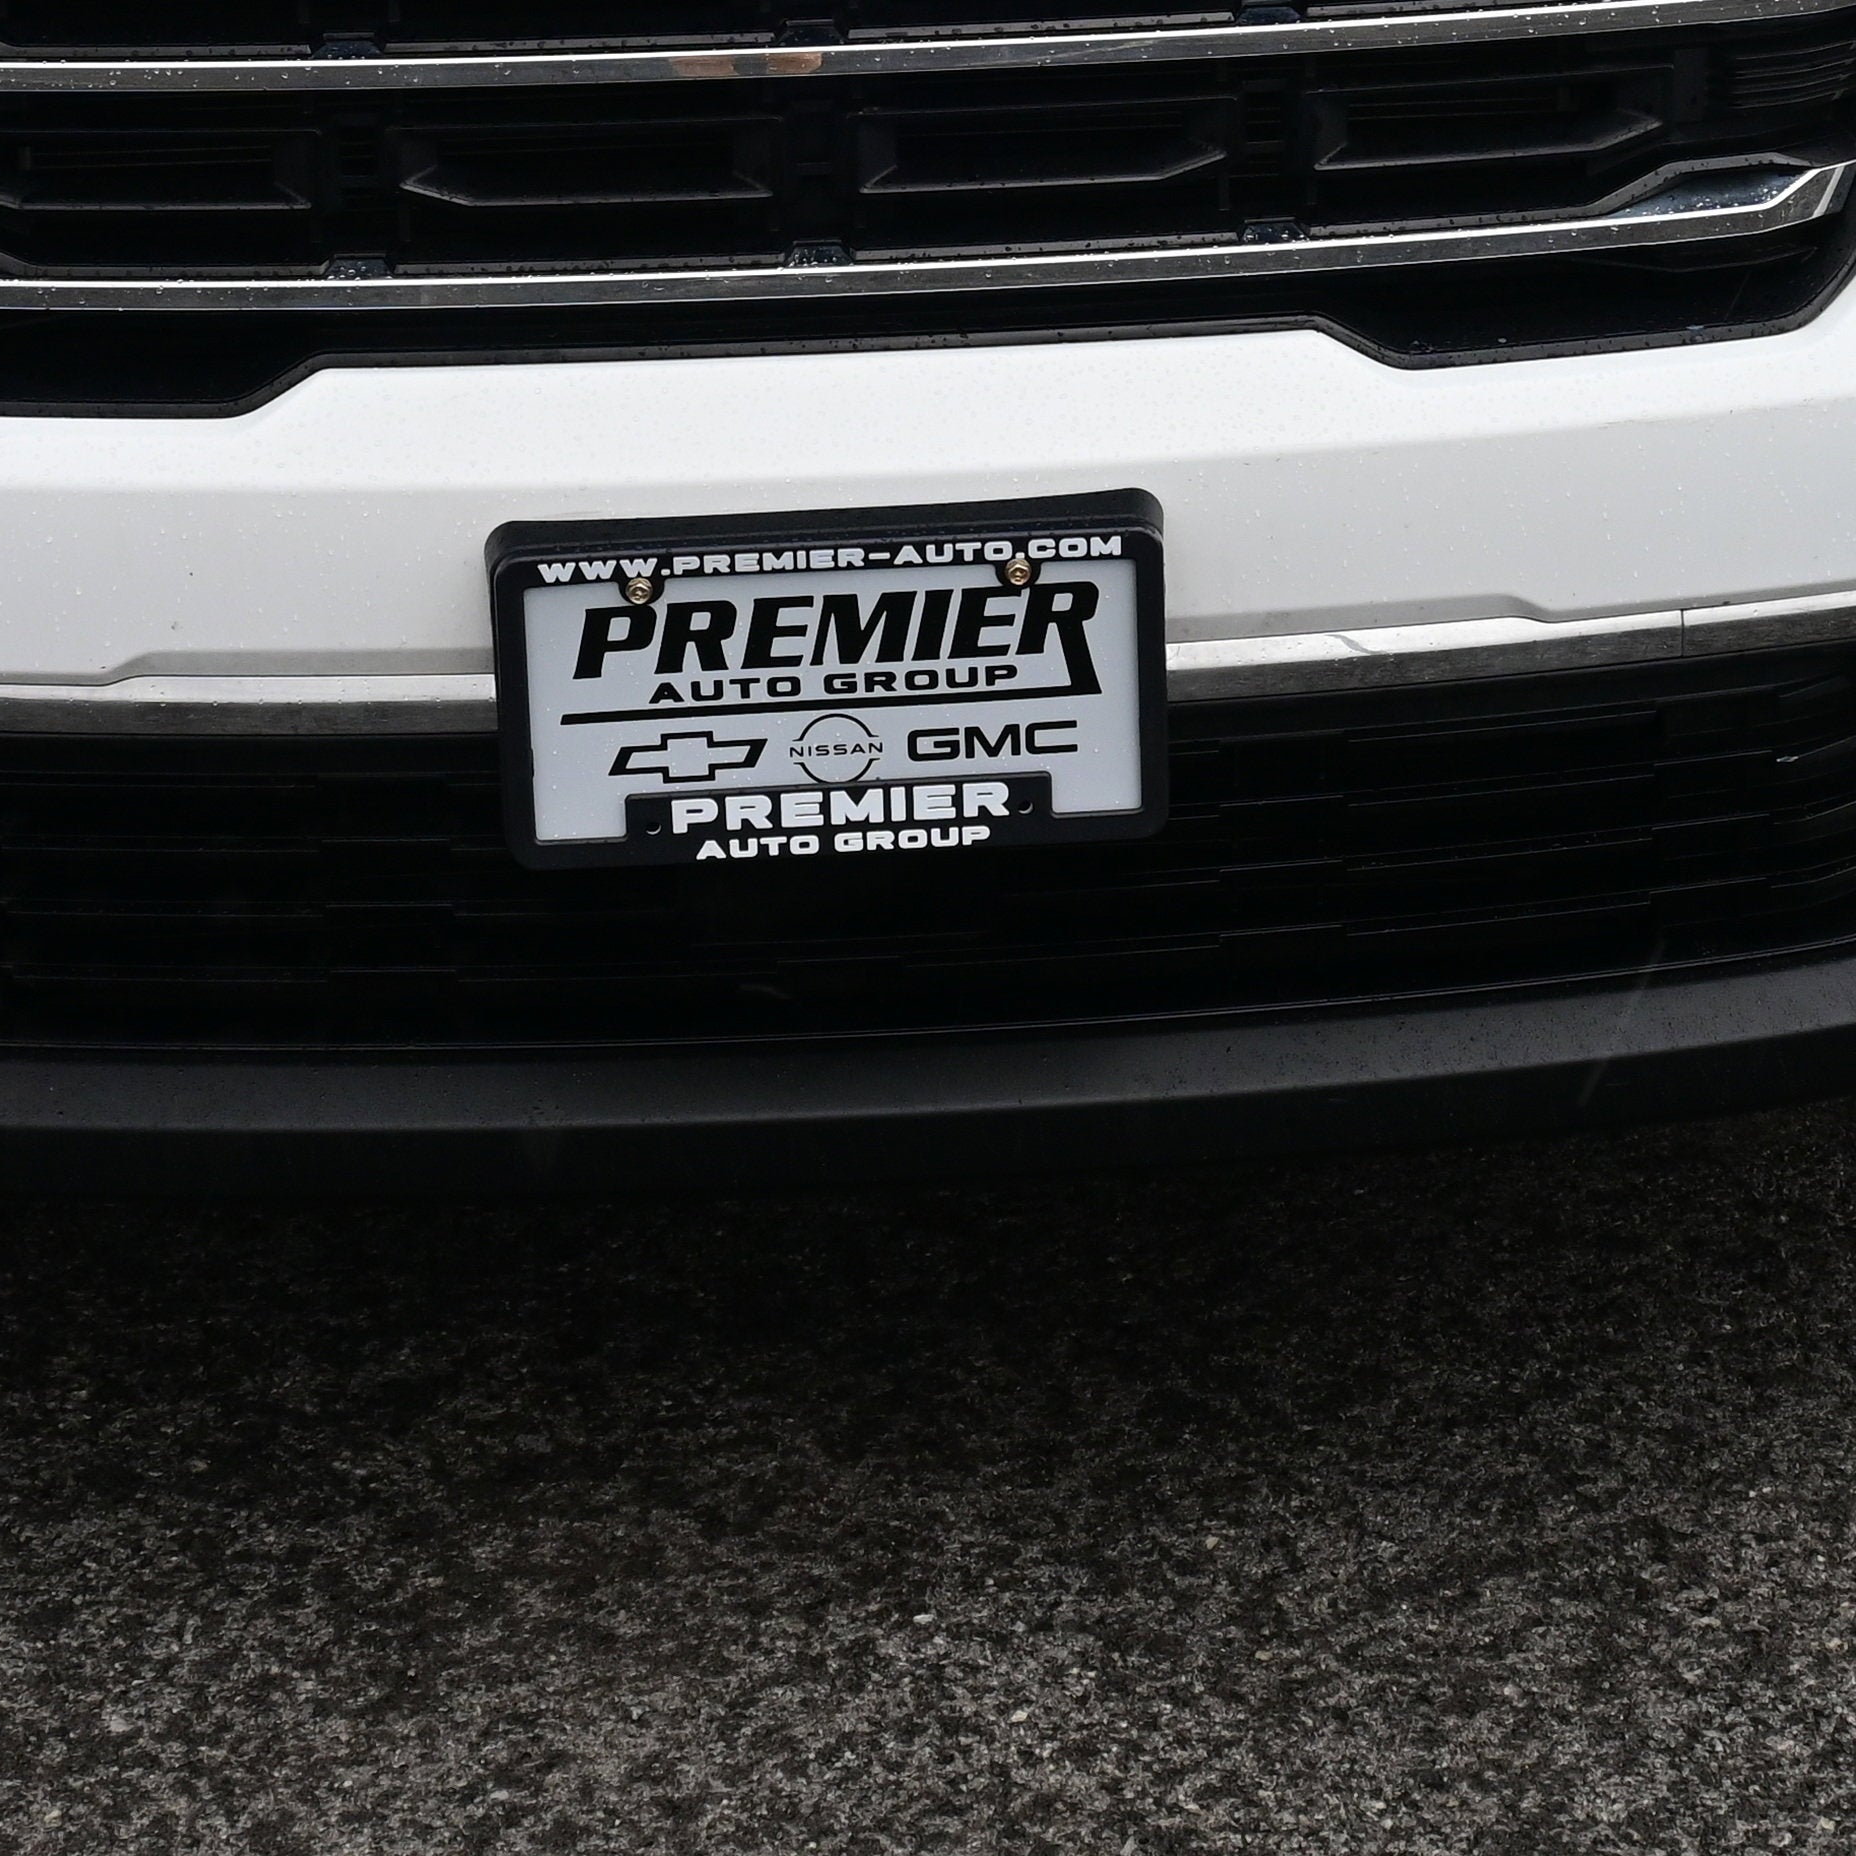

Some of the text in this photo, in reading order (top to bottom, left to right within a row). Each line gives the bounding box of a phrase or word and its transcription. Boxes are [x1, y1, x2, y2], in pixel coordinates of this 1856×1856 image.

[537, 534, 1123, 585] WWW.PREMIER-AUTO.COM
[573, 580, 1102, 694] PREMIER
[648, 663, 1018, 705] AUTO GROUP
[789, 719, 1079, 762] NISSAN GMC
[670, 781, 1010, 835] PREMIER
[695, 824, 992, 861] AUTO GROUP
